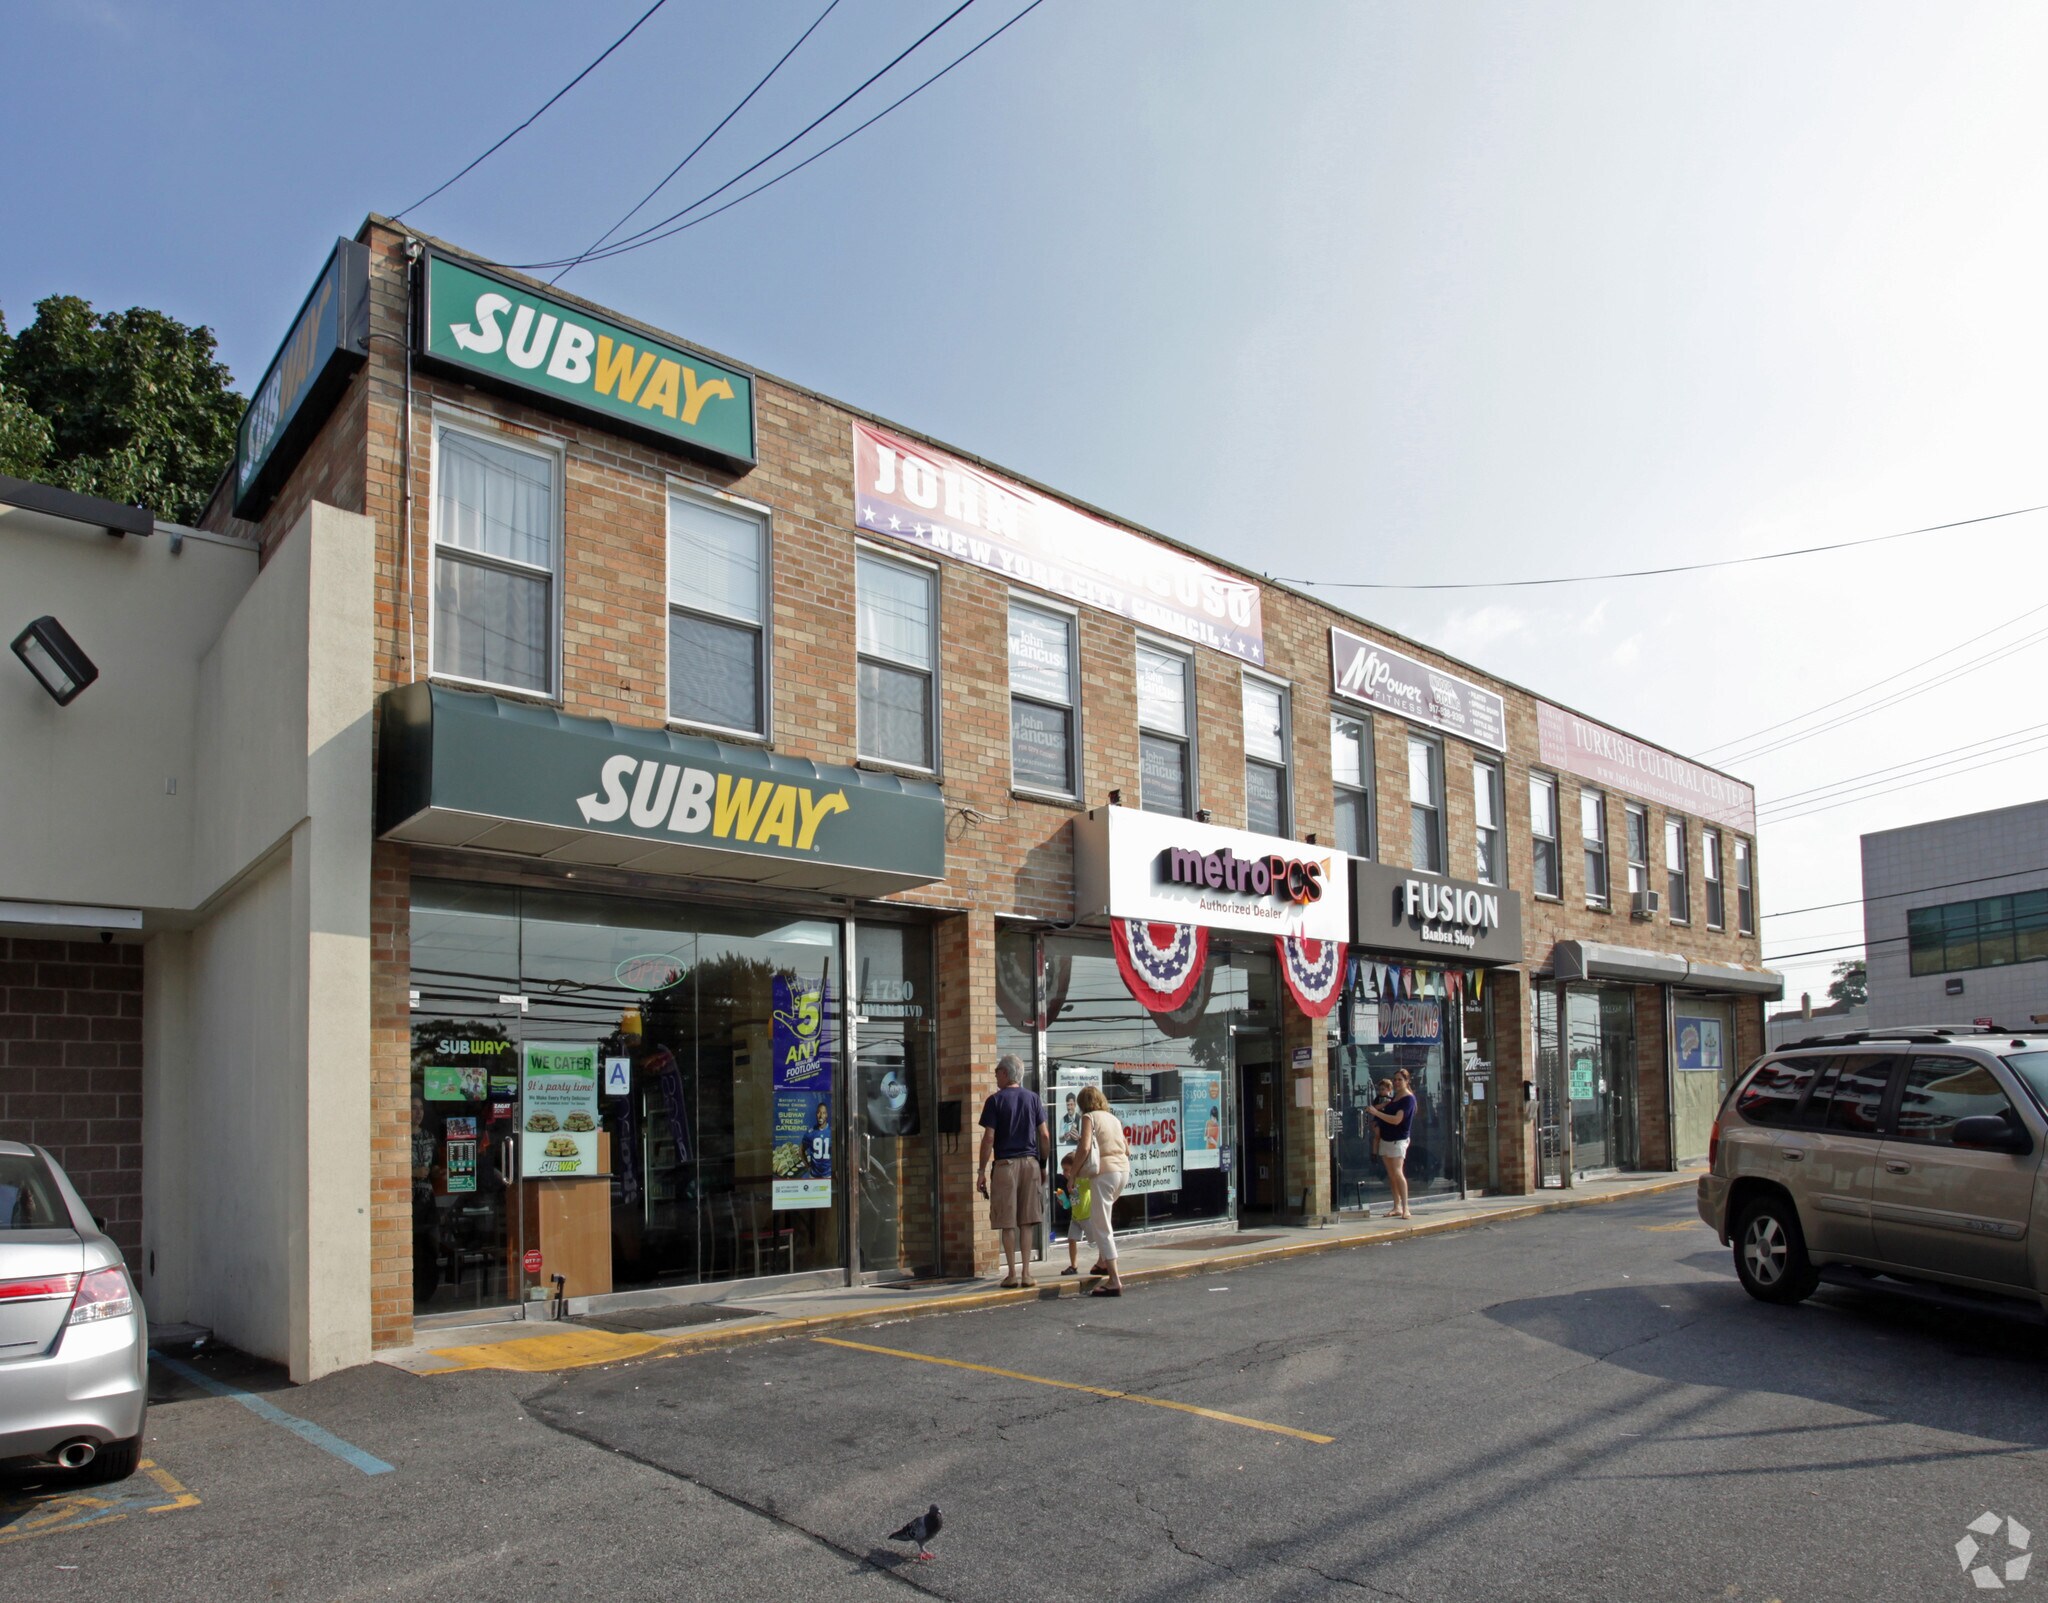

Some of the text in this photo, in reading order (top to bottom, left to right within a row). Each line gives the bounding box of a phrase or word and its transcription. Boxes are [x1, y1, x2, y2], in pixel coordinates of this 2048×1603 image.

[450, 293, 735, 426] SUBWAY
[240, 276, 332, 487] SUBWAY
[874, 443, 1021, 542] JOHN
[930, 524, 1219, 645] NEW YORK CITY COUNCIL
[1020, 630, 1043, 649] John
[1373, 690, 1423, 715] FITNESS
[1021, 714, 1043, 731] John
[1145, 750, 1164, 765] John
[1573, 721, 1746, 809] TURKISH CULTURAL CENTER
[576, 754, 849, 850] SUBWAY
[1170, 846, 1323, 902] metroPCS
[1200, 898, 1282, 919] Authorized Dealer
[1406, 879, 1498, 929] FUSION
[627, 959, 679, 983] OPEN
[870, 980, 914, 1001] 1750
[900, 1004, 923, 1018] BLVD
[1392, 1003, 1439, 1038] OPENING
[435, 1040, 510, 1055] SUBWAY
[785, 1040, 820, 1065] ANY
[531, 1055, 591, 1071] WE CATER
[610, 1063, 626, 1084] A
[786, 1060, 820, 1078] FOOTLONG
[527, 1080, 544, 1091] It's
[545, 1082, 571, 1093] party
[573, 1082, 595, 1091] time!
[1126, 1108, 1137, 1118] your
[1152, 1106, 1170, 1117] phone
[1123, 1119, 1177, 1146] etroPCS
[812, 1137, 830, 1159] 91
[1129, 1152, 1138, 1161] ow
[1140, 1152, 1147, 1160] as
[539, 1158, 581, 1173] SUBWAY
[1134, 1167, 1161, 1177] Samsung
[1137, 1179, 1152, 1188] GSM
[1152, 1178, 1170, 1188] phone
